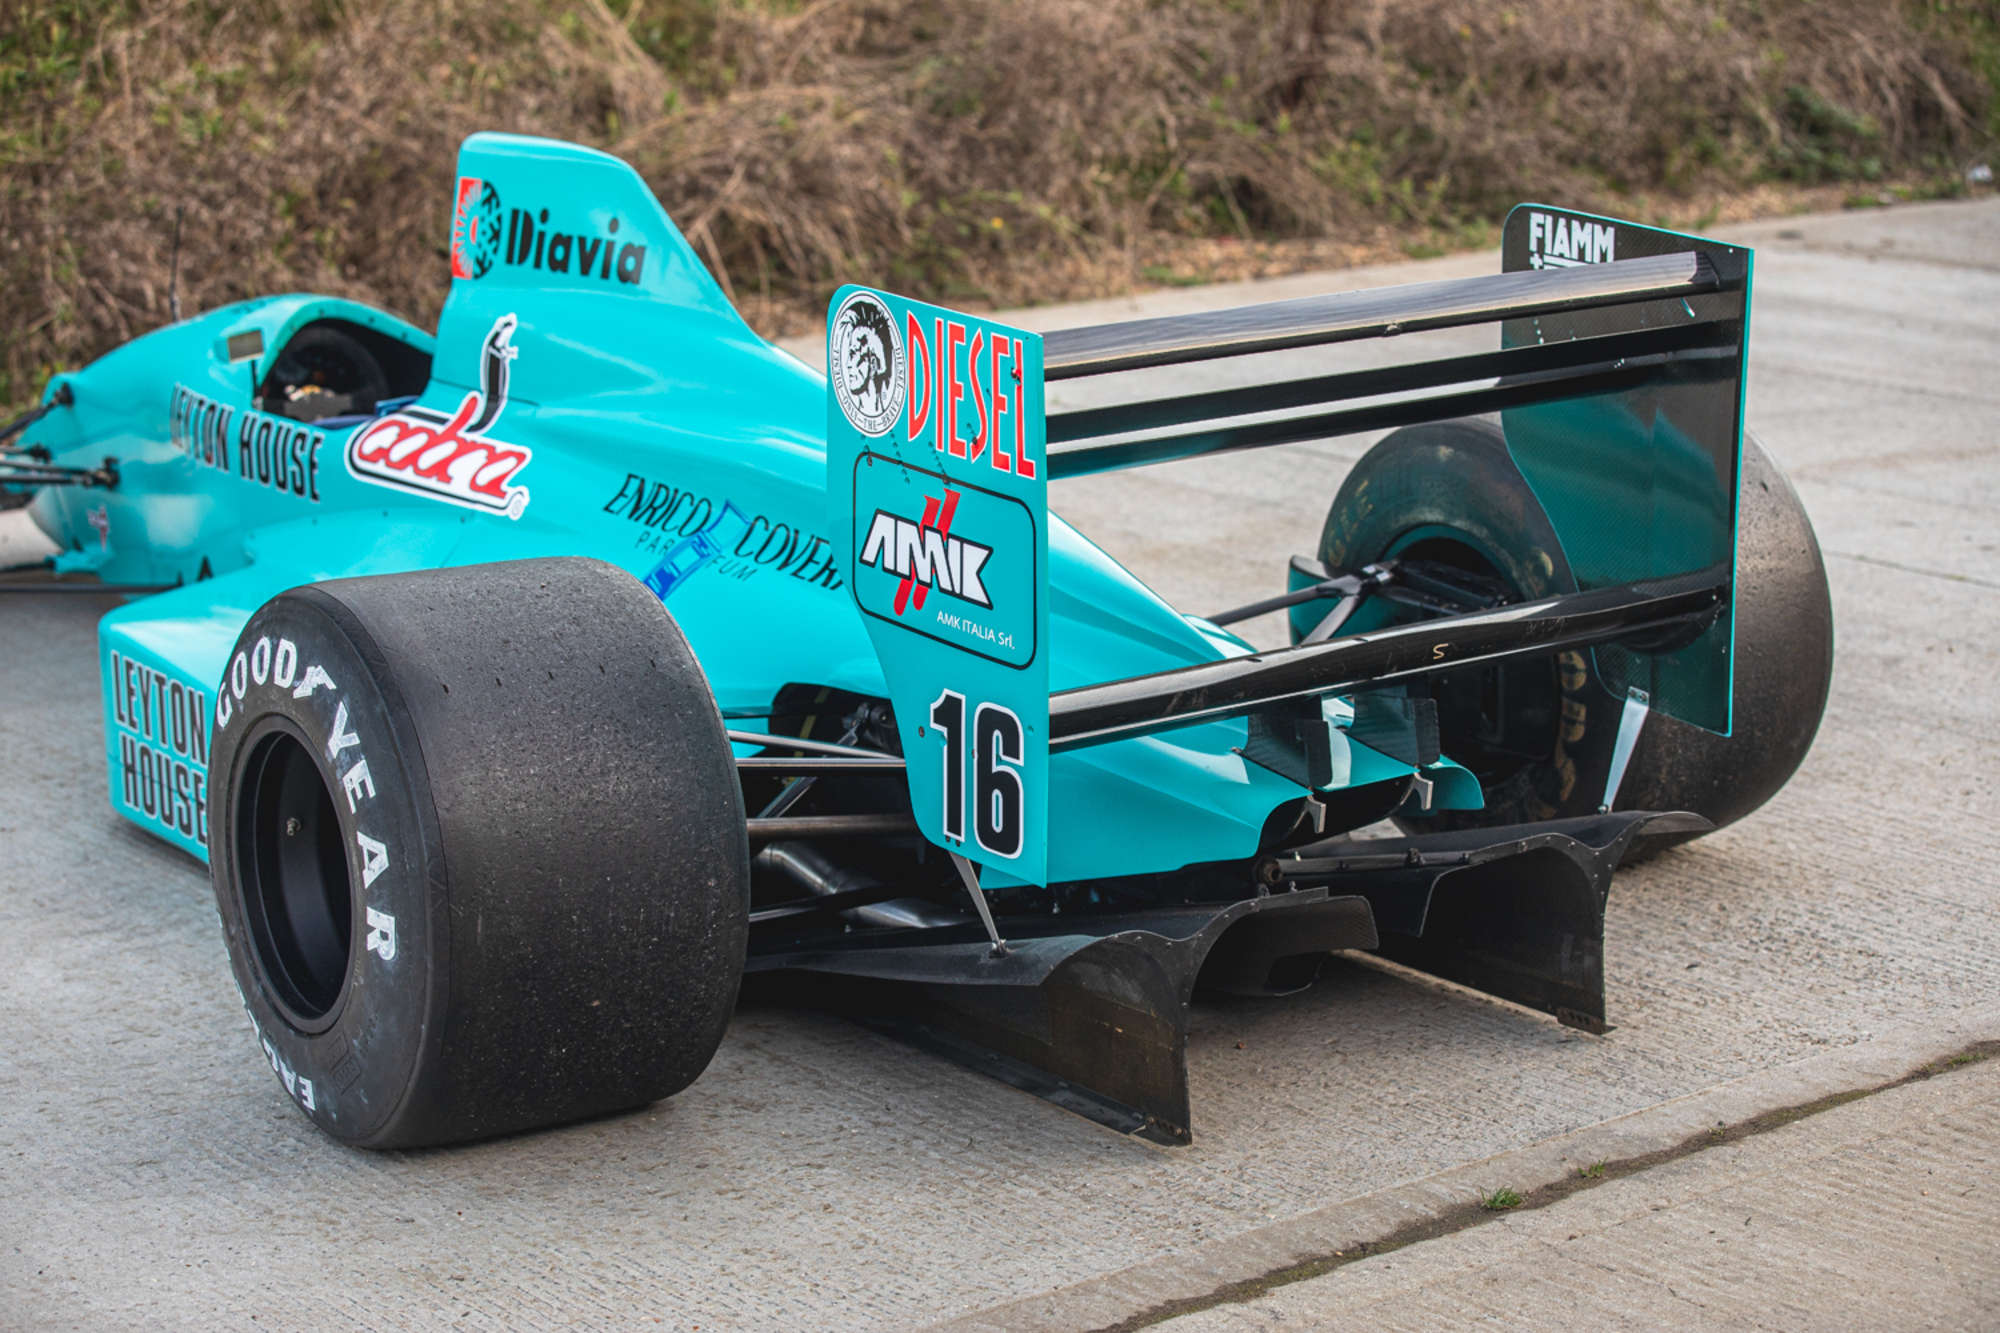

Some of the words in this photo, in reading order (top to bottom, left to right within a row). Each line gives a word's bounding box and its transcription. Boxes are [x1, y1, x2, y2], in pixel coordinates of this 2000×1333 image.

[506, 208, 647, 285] Diavia
[1529, 211, 1615, 265] FIAMM
[170, 382, 234, 474] LEYTON
[240, 410, 325, 503] HOUSE
[357, 396, 527, 499] cobra
[907, 309, 1036, 480] DIESEL
[603, 472, 713, 538] ENRICO
[734, 515, 843, 591] COVER
[936, 610, 961, 630] AMK
[962, 619, 996, 643] ITALIA
[111, 650, 208, 769] LEYTON
[119, 731, 208, 848] HOUSE
[930, 688, 1024, 860] 16
